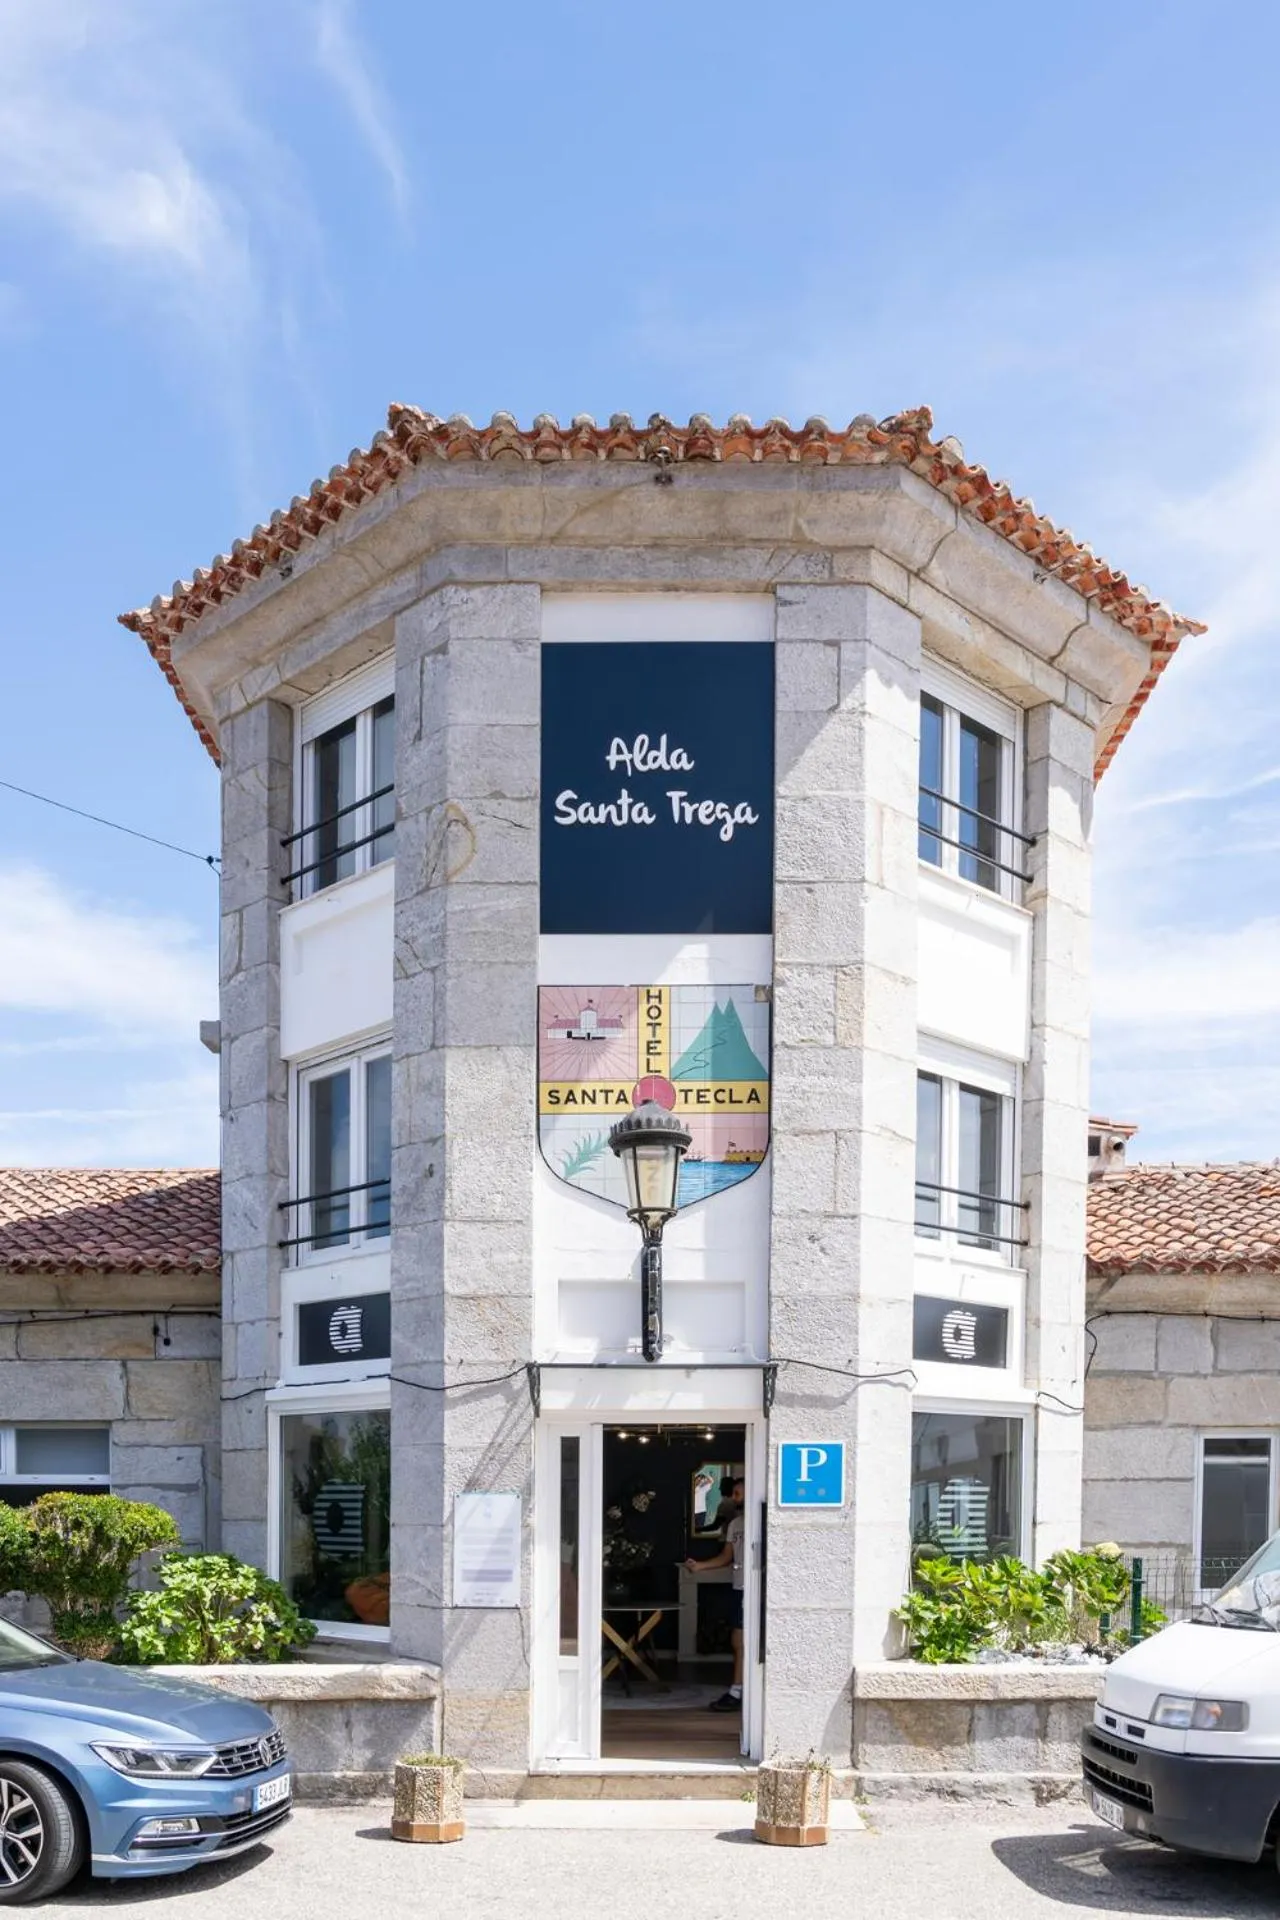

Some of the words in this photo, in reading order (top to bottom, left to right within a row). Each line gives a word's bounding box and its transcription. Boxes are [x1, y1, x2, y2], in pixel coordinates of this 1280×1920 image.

[606, 734, 694, 776] Alda
[555, 789, 656, 825] Santa
[666, 791, 758, 841] Trega
[645, 989, 662, 1074] HOTEL
[548, 1089, 628, 1105] SANTA
[680, 1088, 762, 1104] TECLA
[796, 1447, 826, 1482] P
